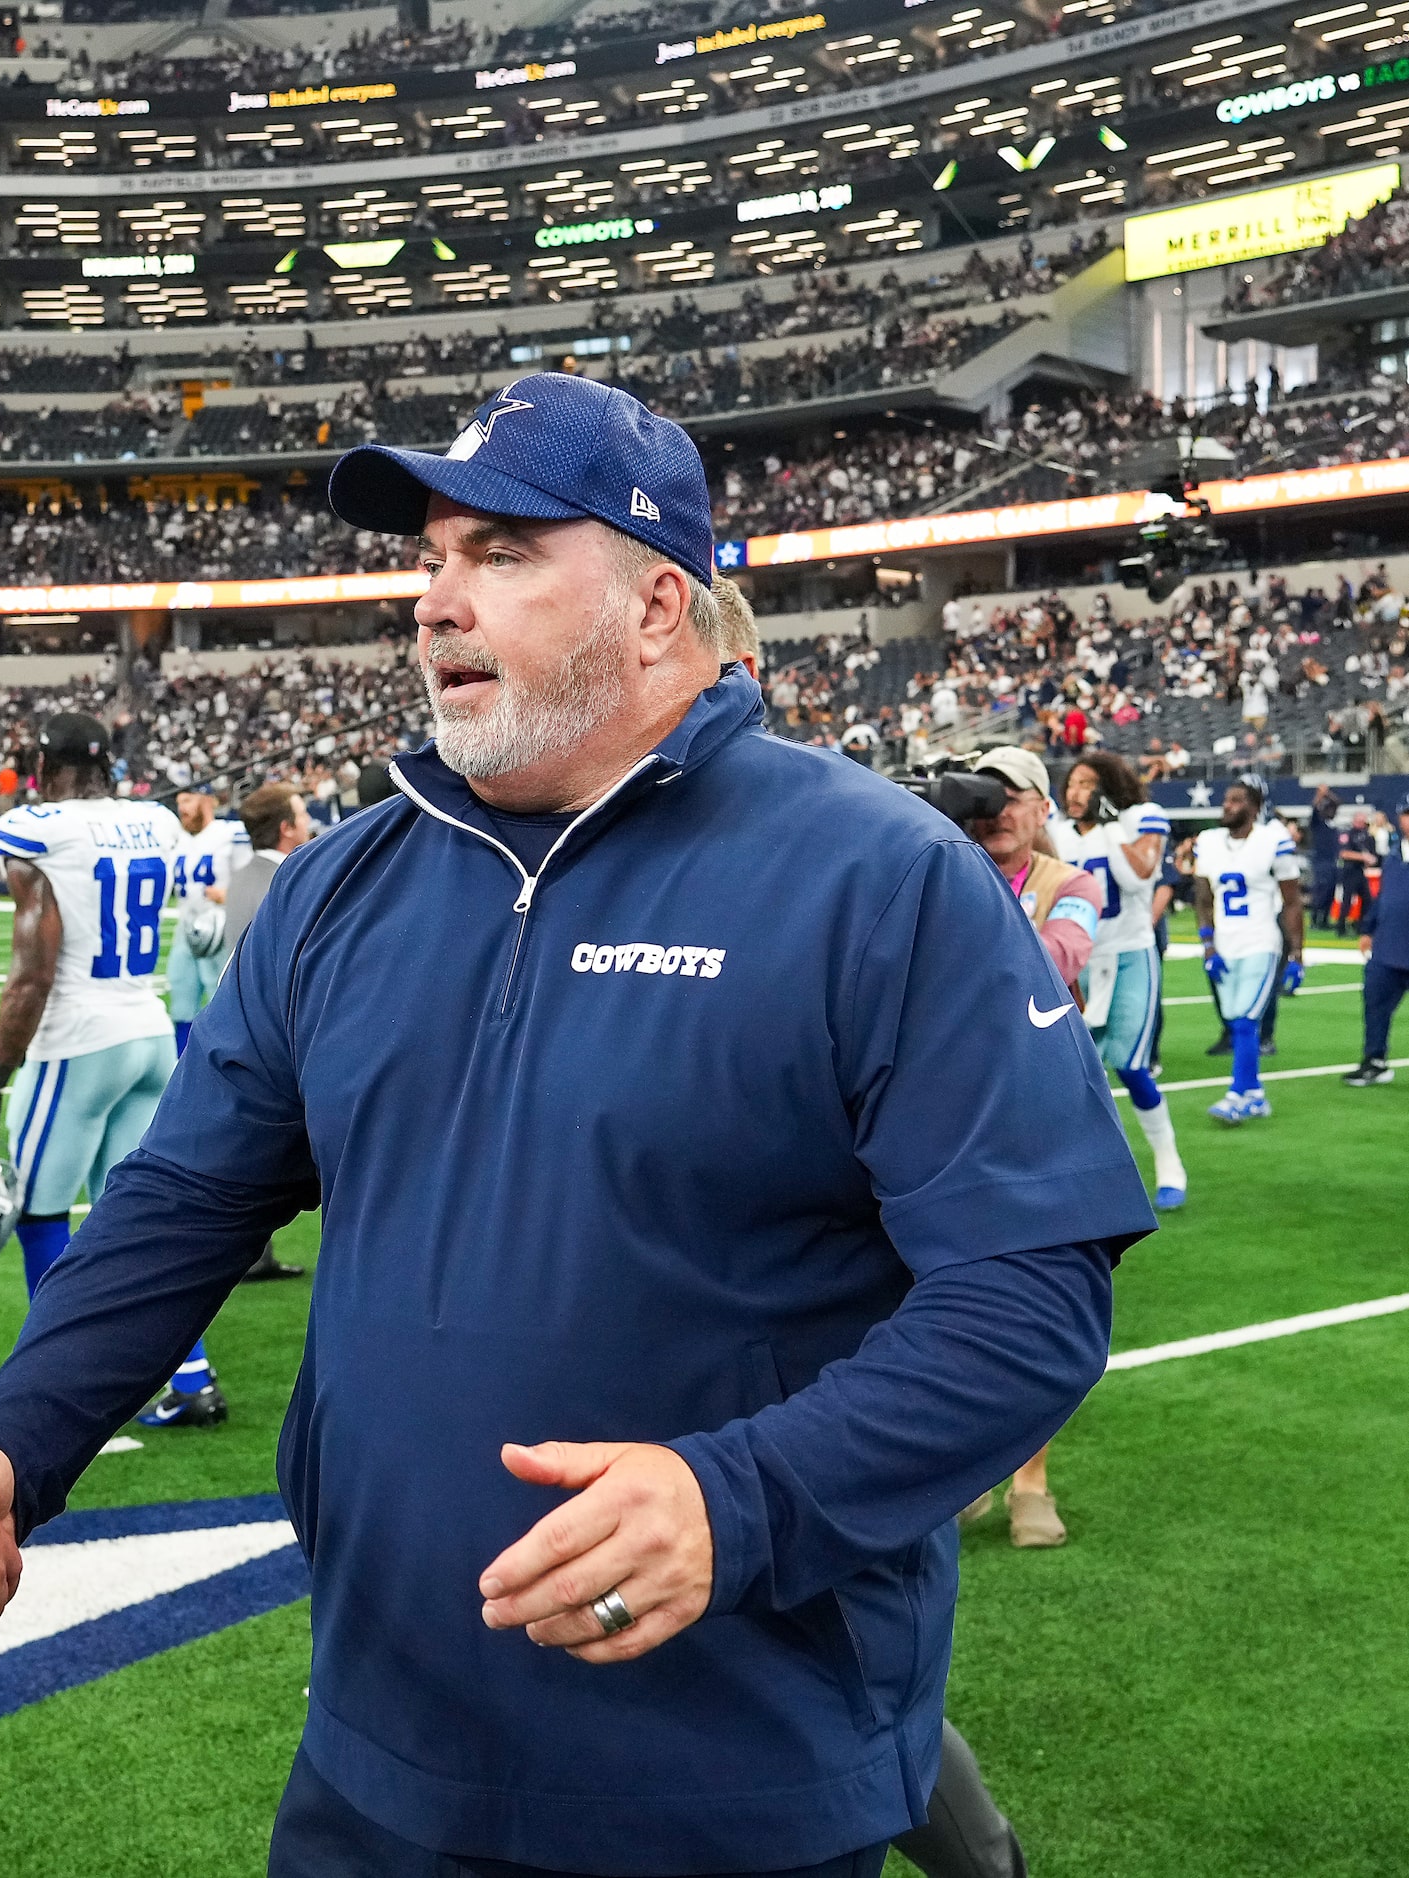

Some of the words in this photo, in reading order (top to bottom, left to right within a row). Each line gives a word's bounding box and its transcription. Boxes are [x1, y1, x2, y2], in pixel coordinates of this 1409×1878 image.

[1216, 75, 1337, 124] COWBOYS
[534, 217, 634, 250] COWBOYS
[1168, 216, 1285, 251] MERRILL
[88, 821, 161, 850] CLARK
[174, 854, 216, 898] 44
[1219, 872, 1249, 917] 2
[91, 856, 167, 979] 18
[570, 942, 727, 979] COWBOYS
